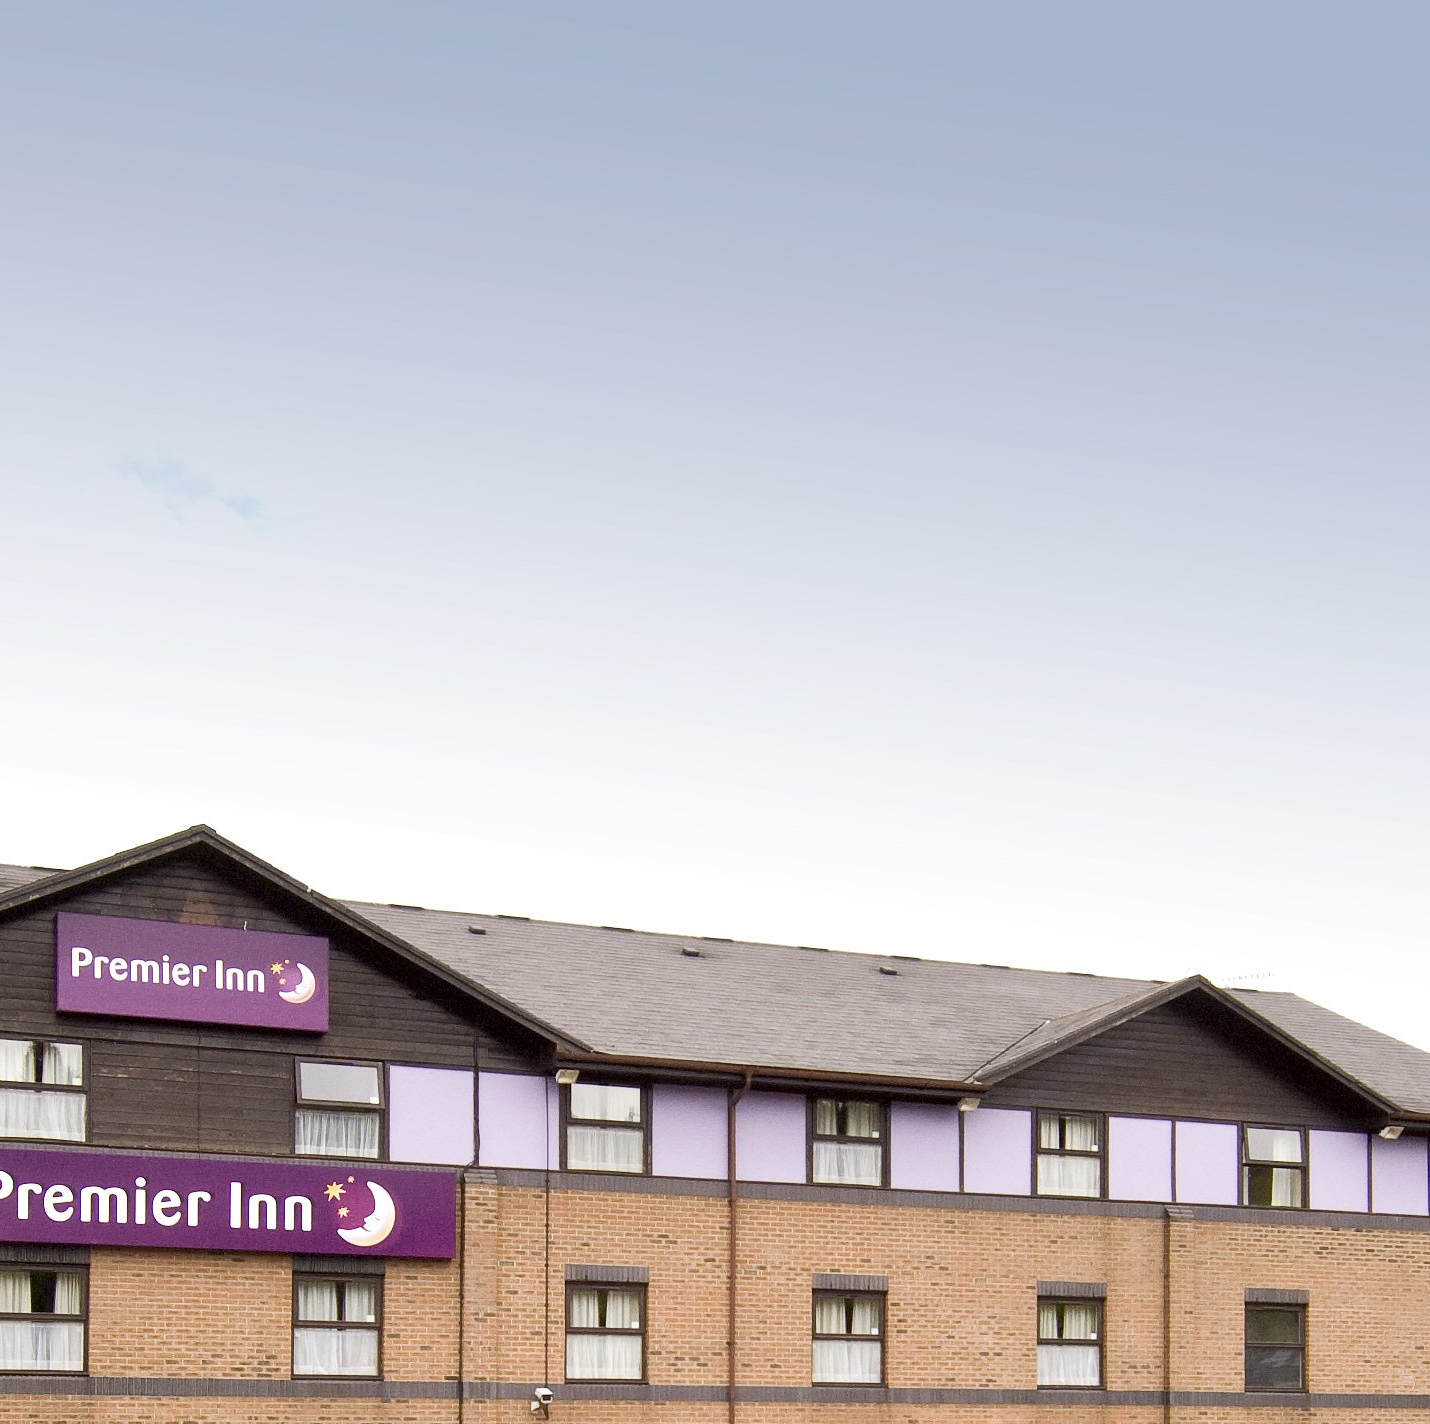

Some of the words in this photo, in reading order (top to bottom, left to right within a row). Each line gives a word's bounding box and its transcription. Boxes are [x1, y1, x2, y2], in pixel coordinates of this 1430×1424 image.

[71, 946, 208, 989] Premier
[216, 958, 265, 993] Inn
[230, 1181, 313, 1232] Inn
